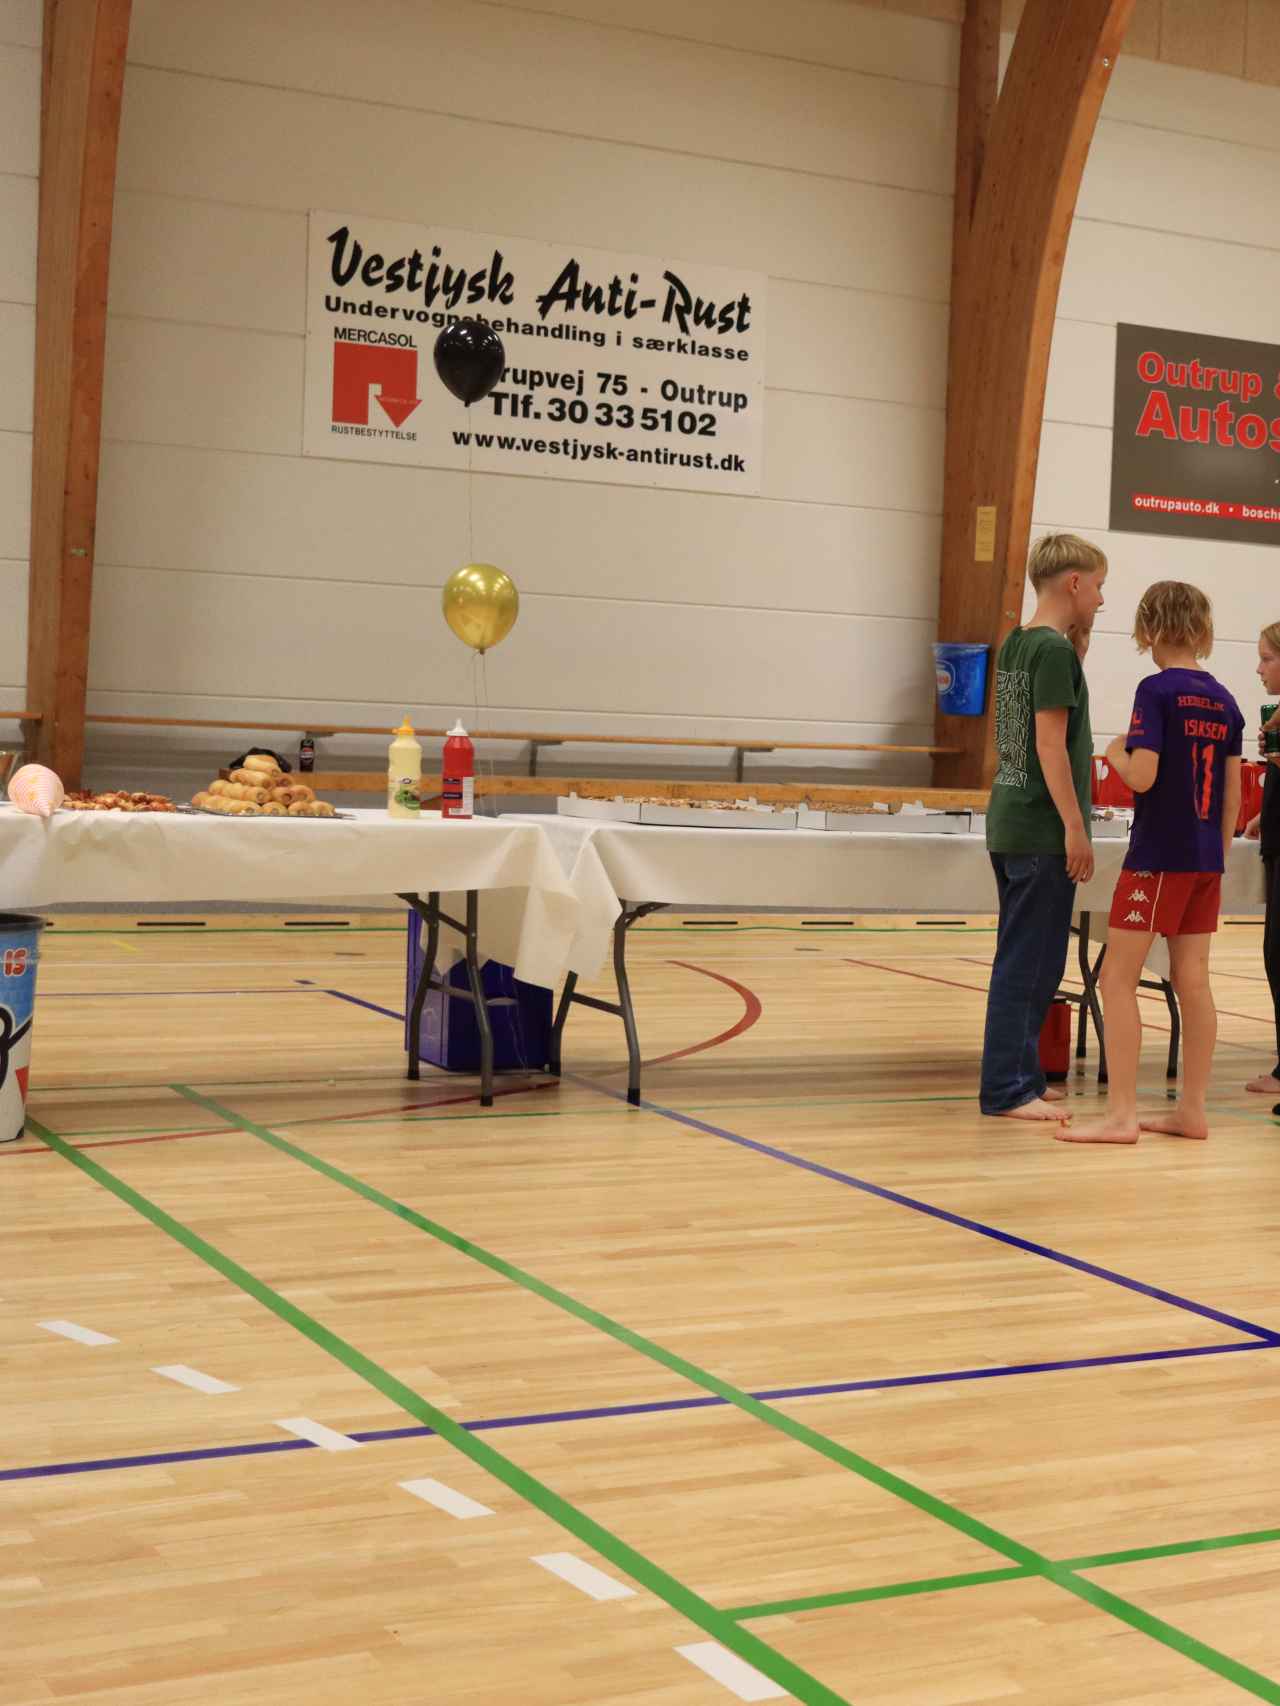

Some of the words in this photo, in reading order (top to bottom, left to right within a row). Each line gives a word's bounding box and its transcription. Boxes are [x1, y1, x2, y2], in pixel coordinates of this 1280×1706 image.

[327, 226, 514, 309] Vestjysk
[536, 258, 751, 336] Anti-Rust
[334, 327, 417, 348] MERCASOL
[616, 331, 622, 346] i
[632, 335, 749, 361] særklasse
[500, 366, 584, 396] rupvej
[597, 372, 628, 396] 75
[660, 379, 748, 413] Outrup
[1137, 351, 1262, 403] Outrup
[488, 391, 541, 420] Tlf.
[547, 397, 588, 424] 30
[595, 403, 634, 428] 33
[452, 431, 745, 472] www.vestjysk-antirust.dk
[1135, 495, 1220, 514] outrupauto.dk
